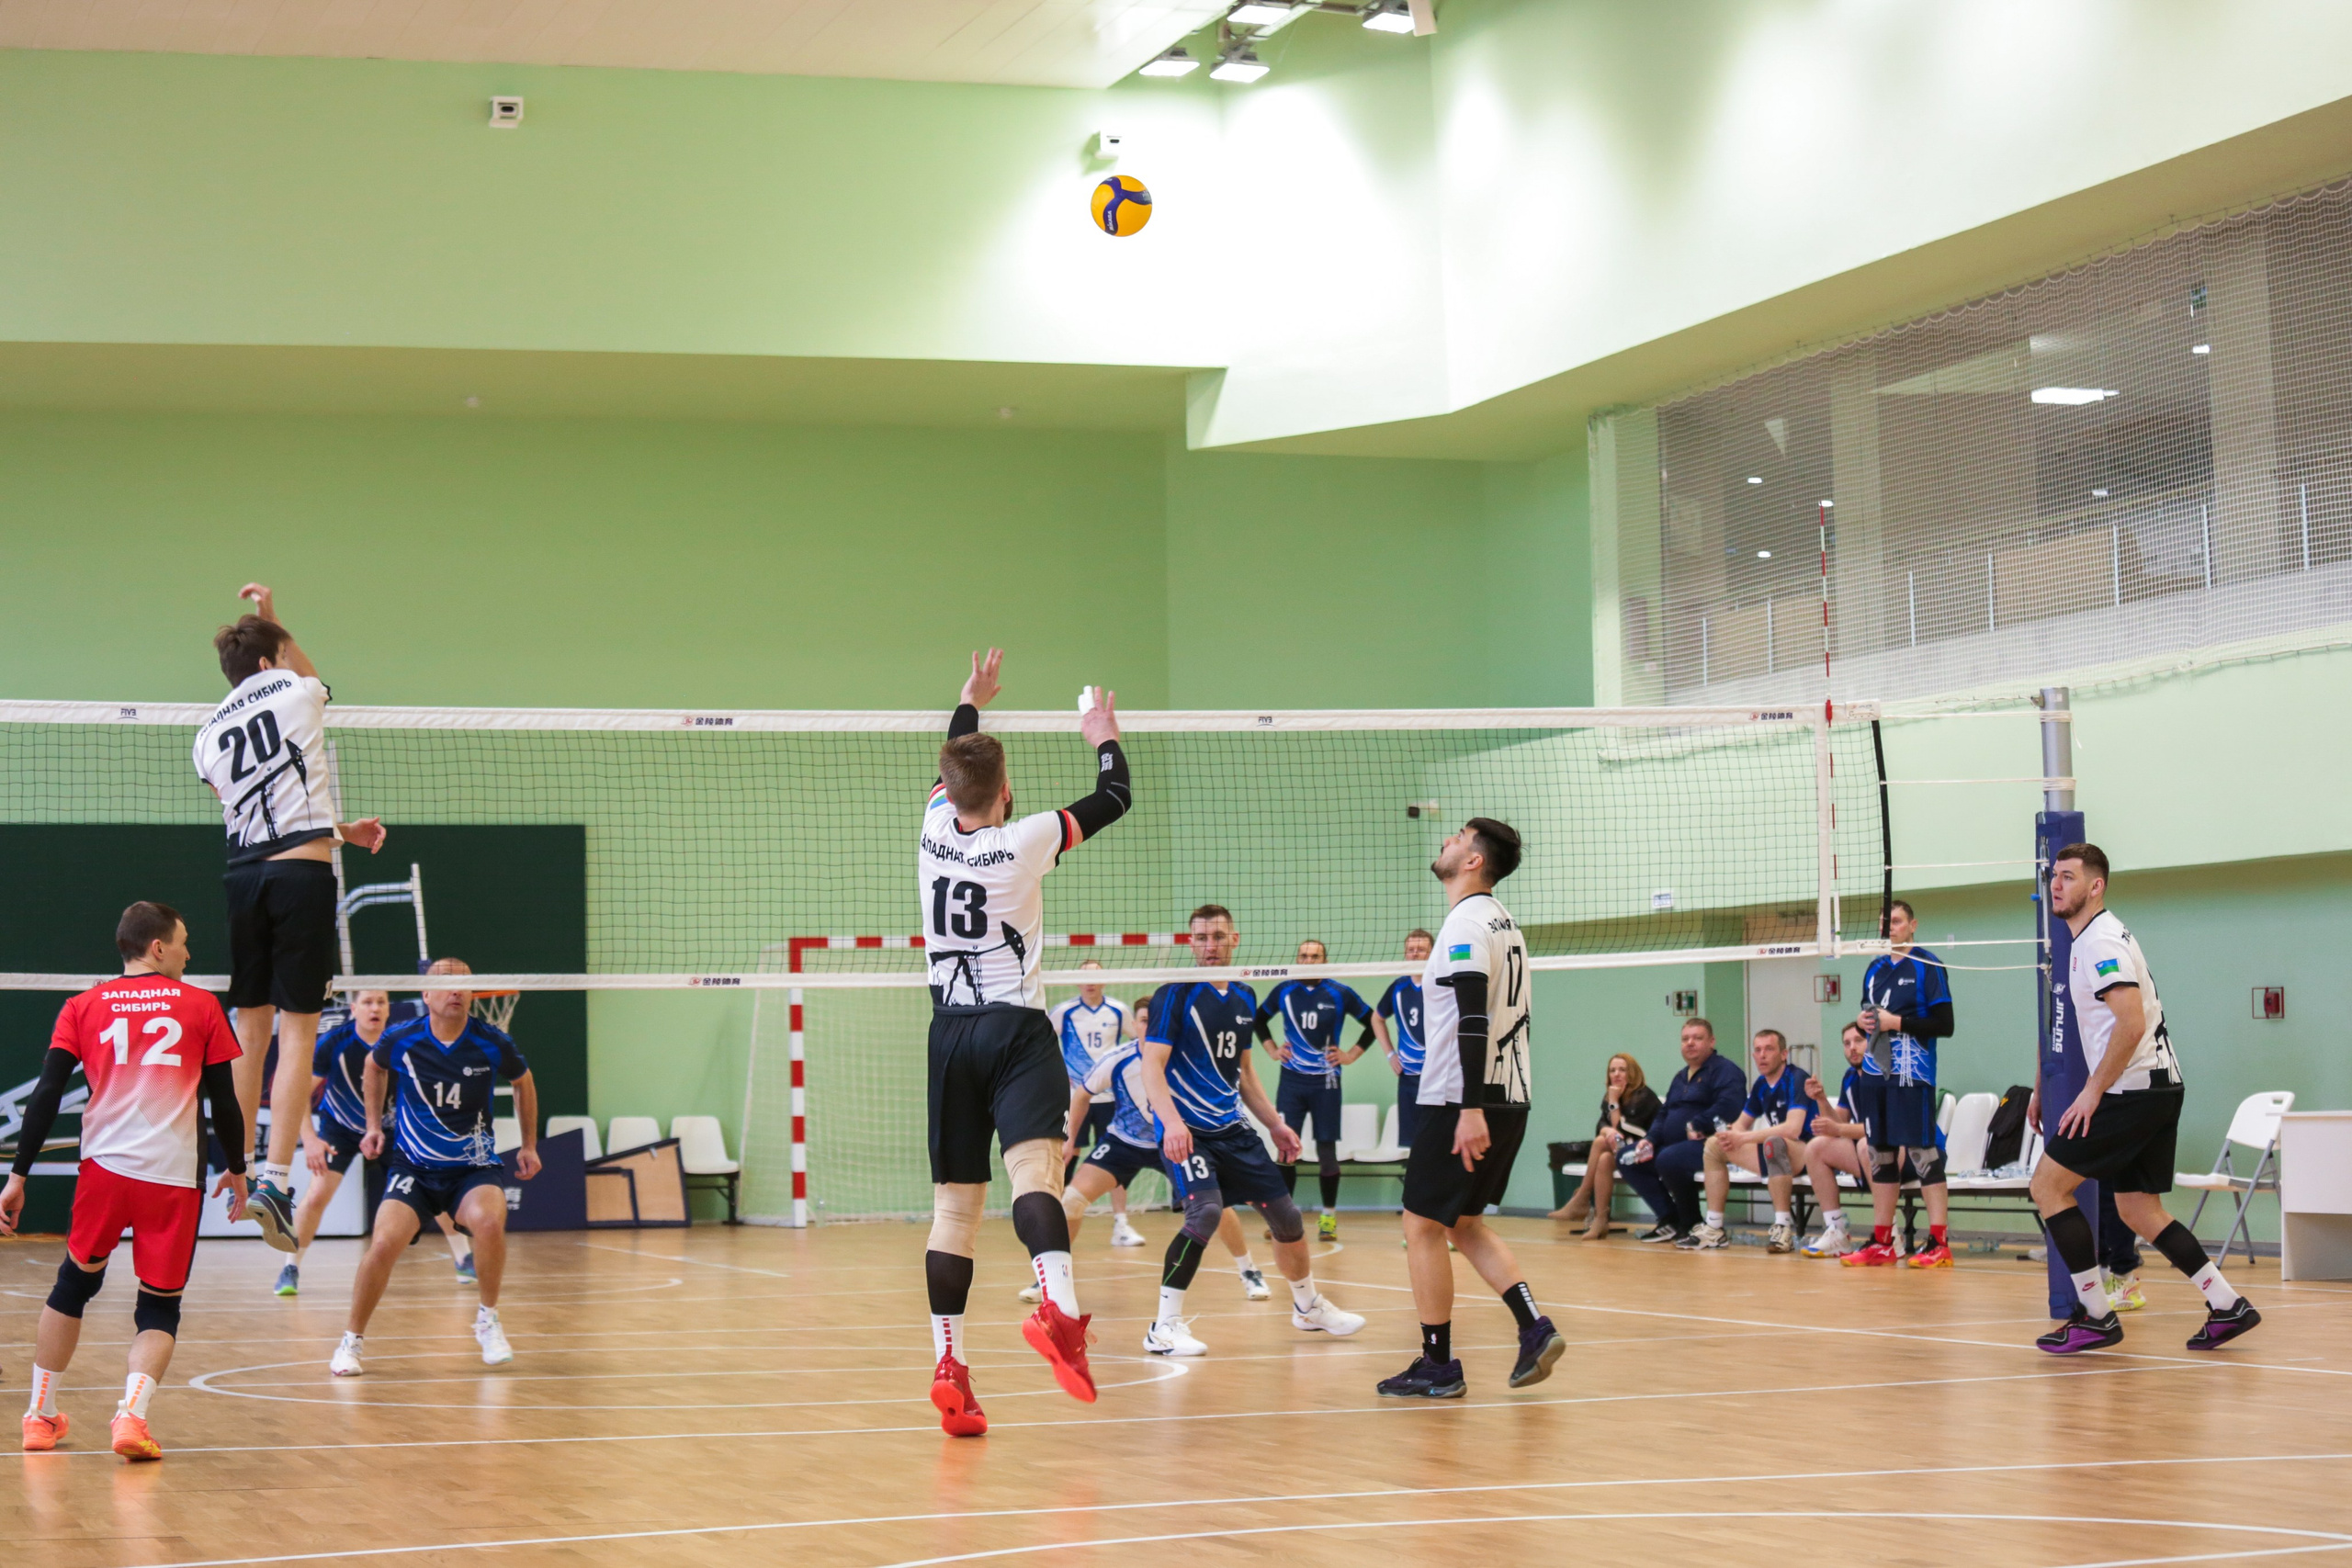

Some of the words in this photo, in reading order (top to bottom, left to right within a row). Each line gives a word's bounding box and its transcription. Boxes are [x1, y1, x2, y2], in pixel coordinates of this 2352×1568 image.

[247, 678, 292, 704] СИБИРЬ
[218, 709, 281, 784] 20
[932, 875, 988, 940] 13
[1507, 945, 1522, 1007] 17
[102, 988, 181, 999] ЗАПАДНАЯ
[1880, 988, 1892, 1010] 4
[111, 1002, 171, 1012] СИБИРЬ
[1409, 1008, 1419, 1027] 3
[1301, 1011, 1318, 1030] 10
[2055, 998, 2064, 1054] JINLING
[99, 1016, 183, 1067] 12
[1087, 1032, 1102, 1048] 15
[1216, 1031, 1237, 1058] 13
[434, 1081, 462, 1109] 14
[1091, 1144, 1111, 1159] 8
[1181, 1156, 1209, 1182] 13
[387, 1174, 414, 1195] 14
